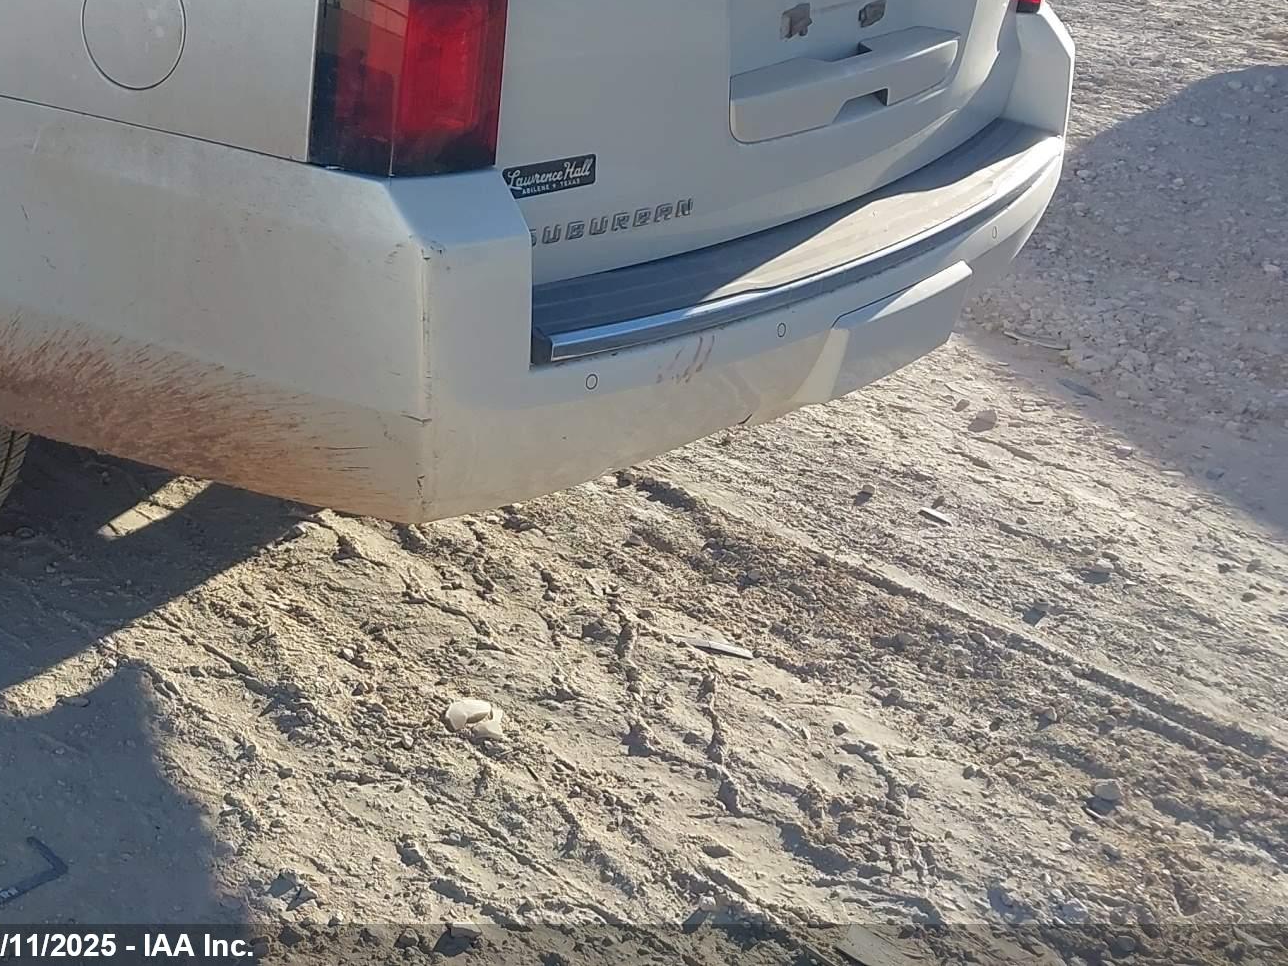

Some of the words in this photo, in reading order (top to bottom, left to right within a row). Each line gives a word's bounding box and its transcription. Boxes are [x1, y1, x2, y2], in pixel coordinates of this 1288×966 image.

[508, 170, 563, 190] Lawrence
[563, 158, 593, 180] Hall
[522, 184, 549, 195] ABILENE
[559, 178, 580, 187] TEXAS
